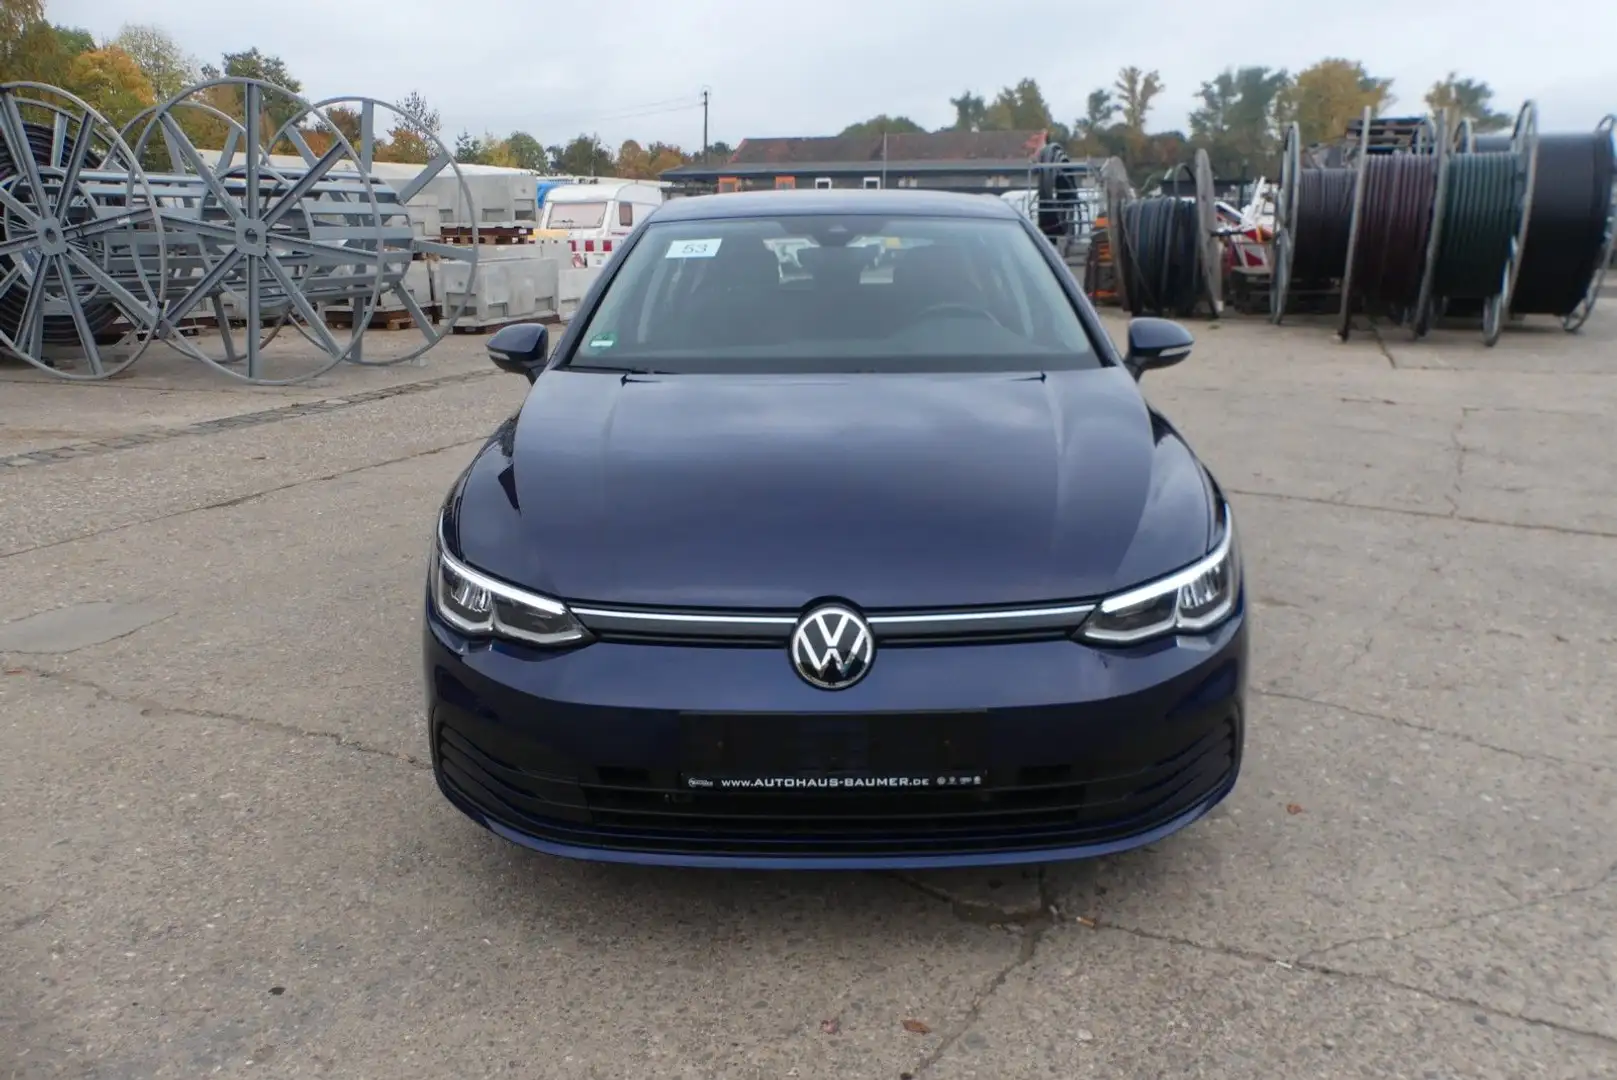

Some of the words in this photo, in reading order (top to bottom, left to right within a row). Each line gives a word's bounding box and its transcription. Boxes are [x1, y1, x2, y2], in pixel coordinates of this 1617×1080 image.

[682, 243, 708, 254] 53
[799, 611, 867, 679] VW
[721, 777, 929, 787] www.AUTOHAUS-BAUMER.DE
